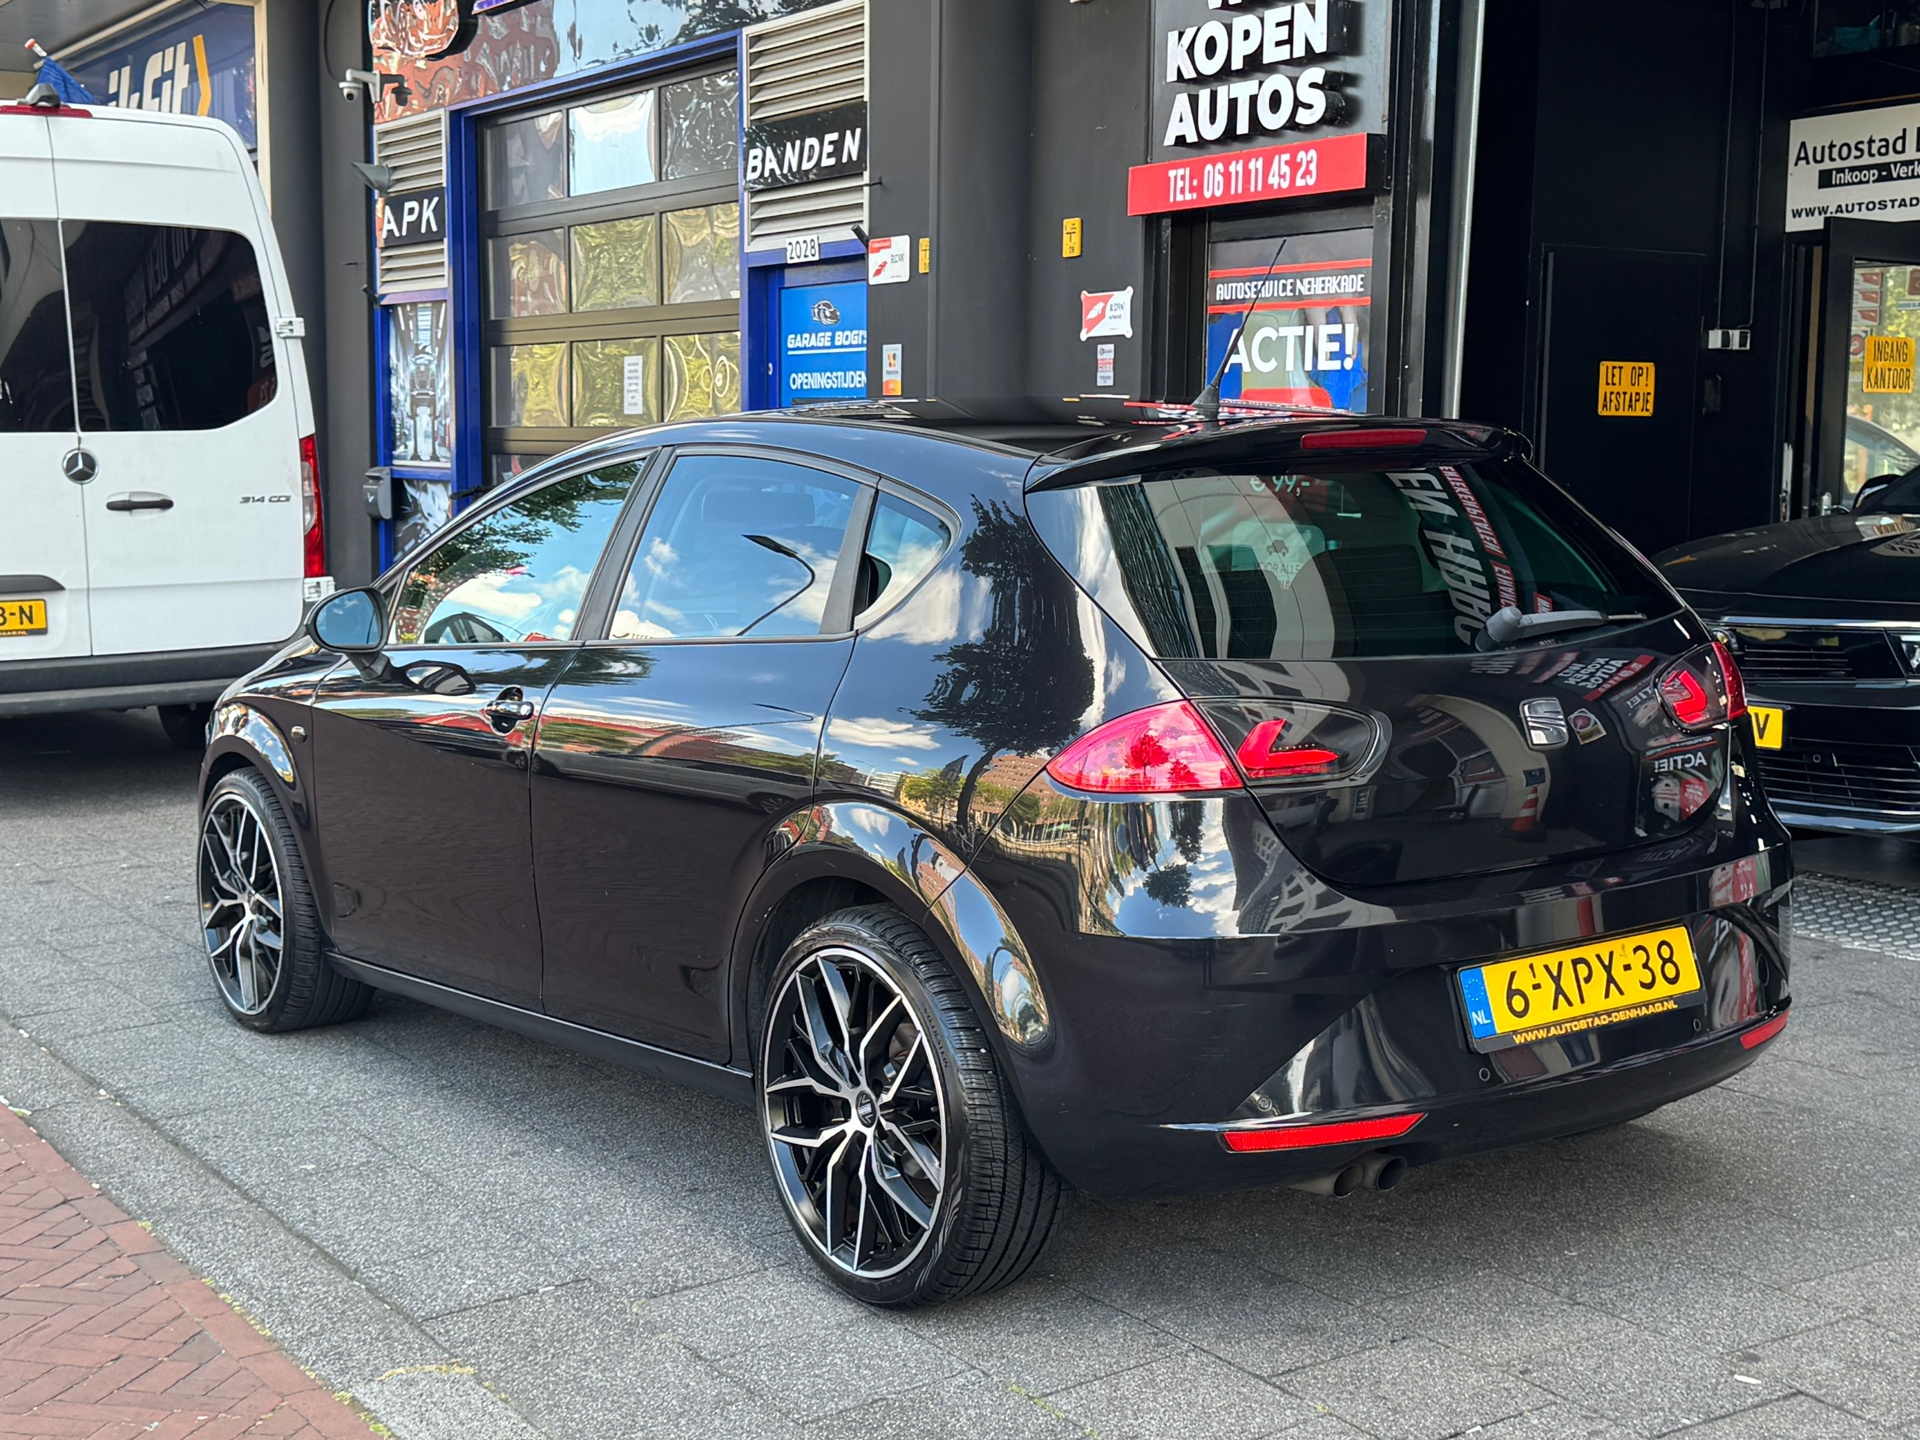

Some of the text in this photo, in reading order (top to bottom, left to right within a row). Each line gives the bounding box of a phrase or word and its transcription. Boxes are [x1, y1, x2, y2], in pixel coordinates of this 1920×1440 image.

[1166, 0, 1328, 82] KOPEN
[1163, 67, 1327, 146] AUTOS
[748, 128, 862, 180] BANDEN
[1794, 128, 1907, 167] Autostad
[1168, 149, 1318, 203] TEL: 06 11 11 45 23
[1831, 168, 1878, 185] Inkoop
[381, 196, 439, 239] APK
[1791, 196, 1920, 219] WWW.AUTOSTAD
[787, 238, 817, 261] 2028
[1216, 274, 1365, 301] AUTOSERVICE NEHERKADE
[787, 332, 832, 348] GARAGE
[1223, 323, 1355, 373] ACTIE!
[1873, 339, 1909, 363] INGANG
[1604, 365, 1650, 387] LET OP!
[1866, 366, 1911, 390] KANTOOR
[1602, 390, 1651, 414] AFSTAPJE
[1471, 1010, 1491, 1026] NL
[1512, 1000, 1678, 1045] WWW.AUTOSTAD-DENHAAG.NL
